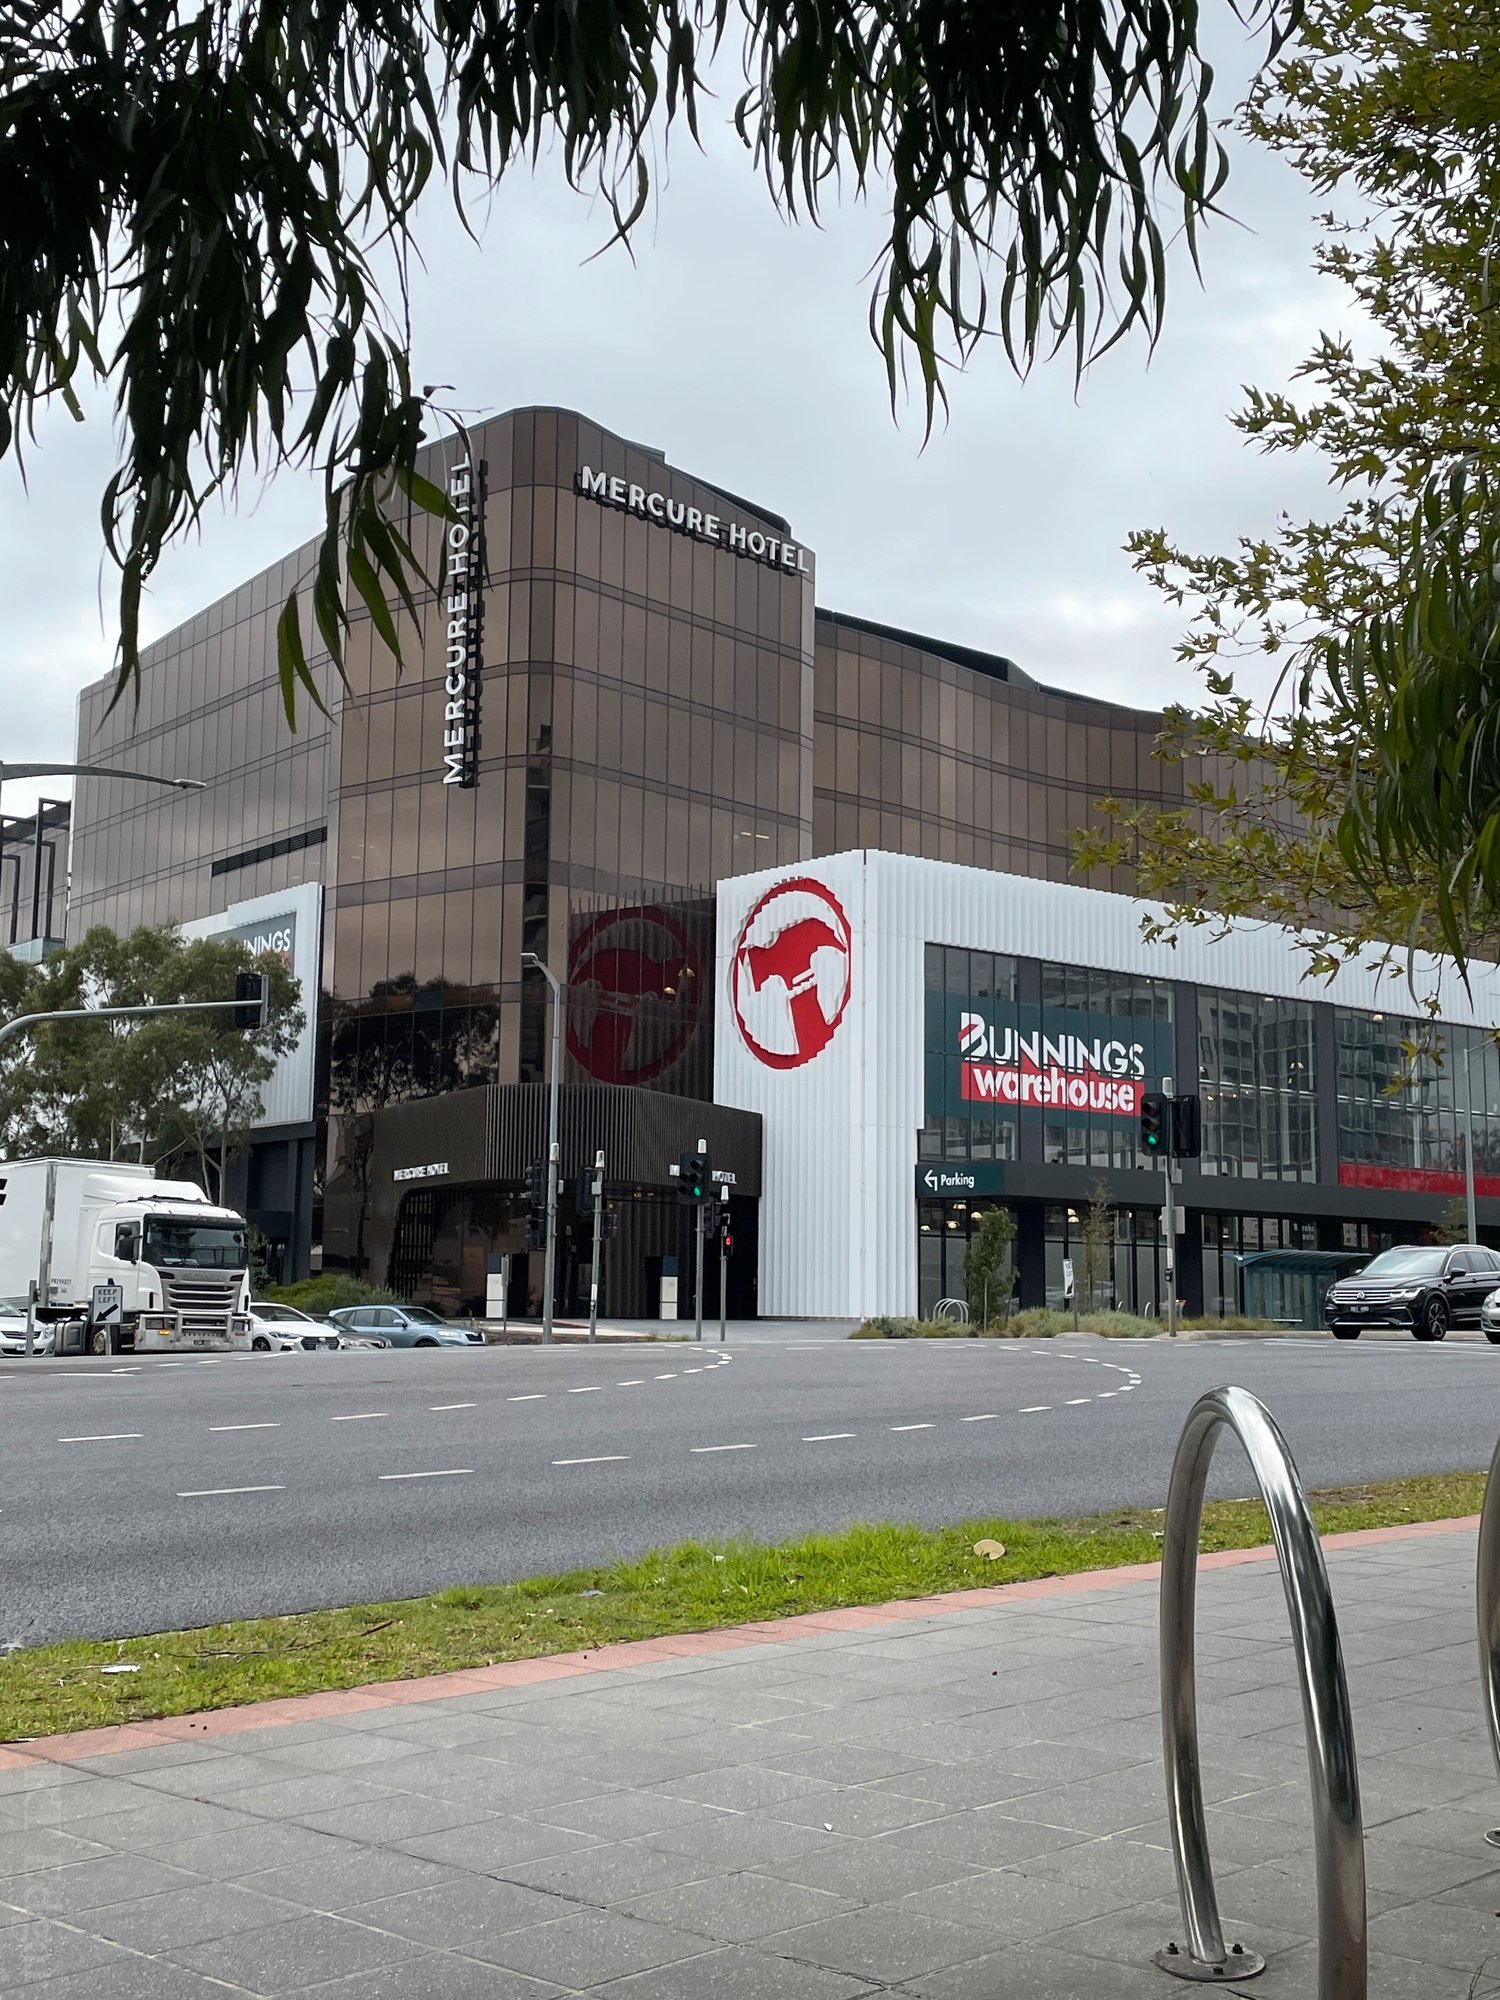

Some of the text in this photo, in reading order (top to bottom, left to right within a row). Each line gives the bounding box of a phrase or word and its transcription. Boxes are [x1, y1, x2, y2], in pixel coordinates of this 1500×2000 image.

[581, 466, 810, 573] MERCURE HOTEL
[443, 593, 468, 785] MERCURE
[959, 1012, 1145, 1080] BUNNINGS
[973, 1067, 1135, 1112] warehouse
[941, 1172, 975, 1189] Parking
[97, 1288, 118, 1296] KEEP
[98, 1296, 117, 1304] LEFT
